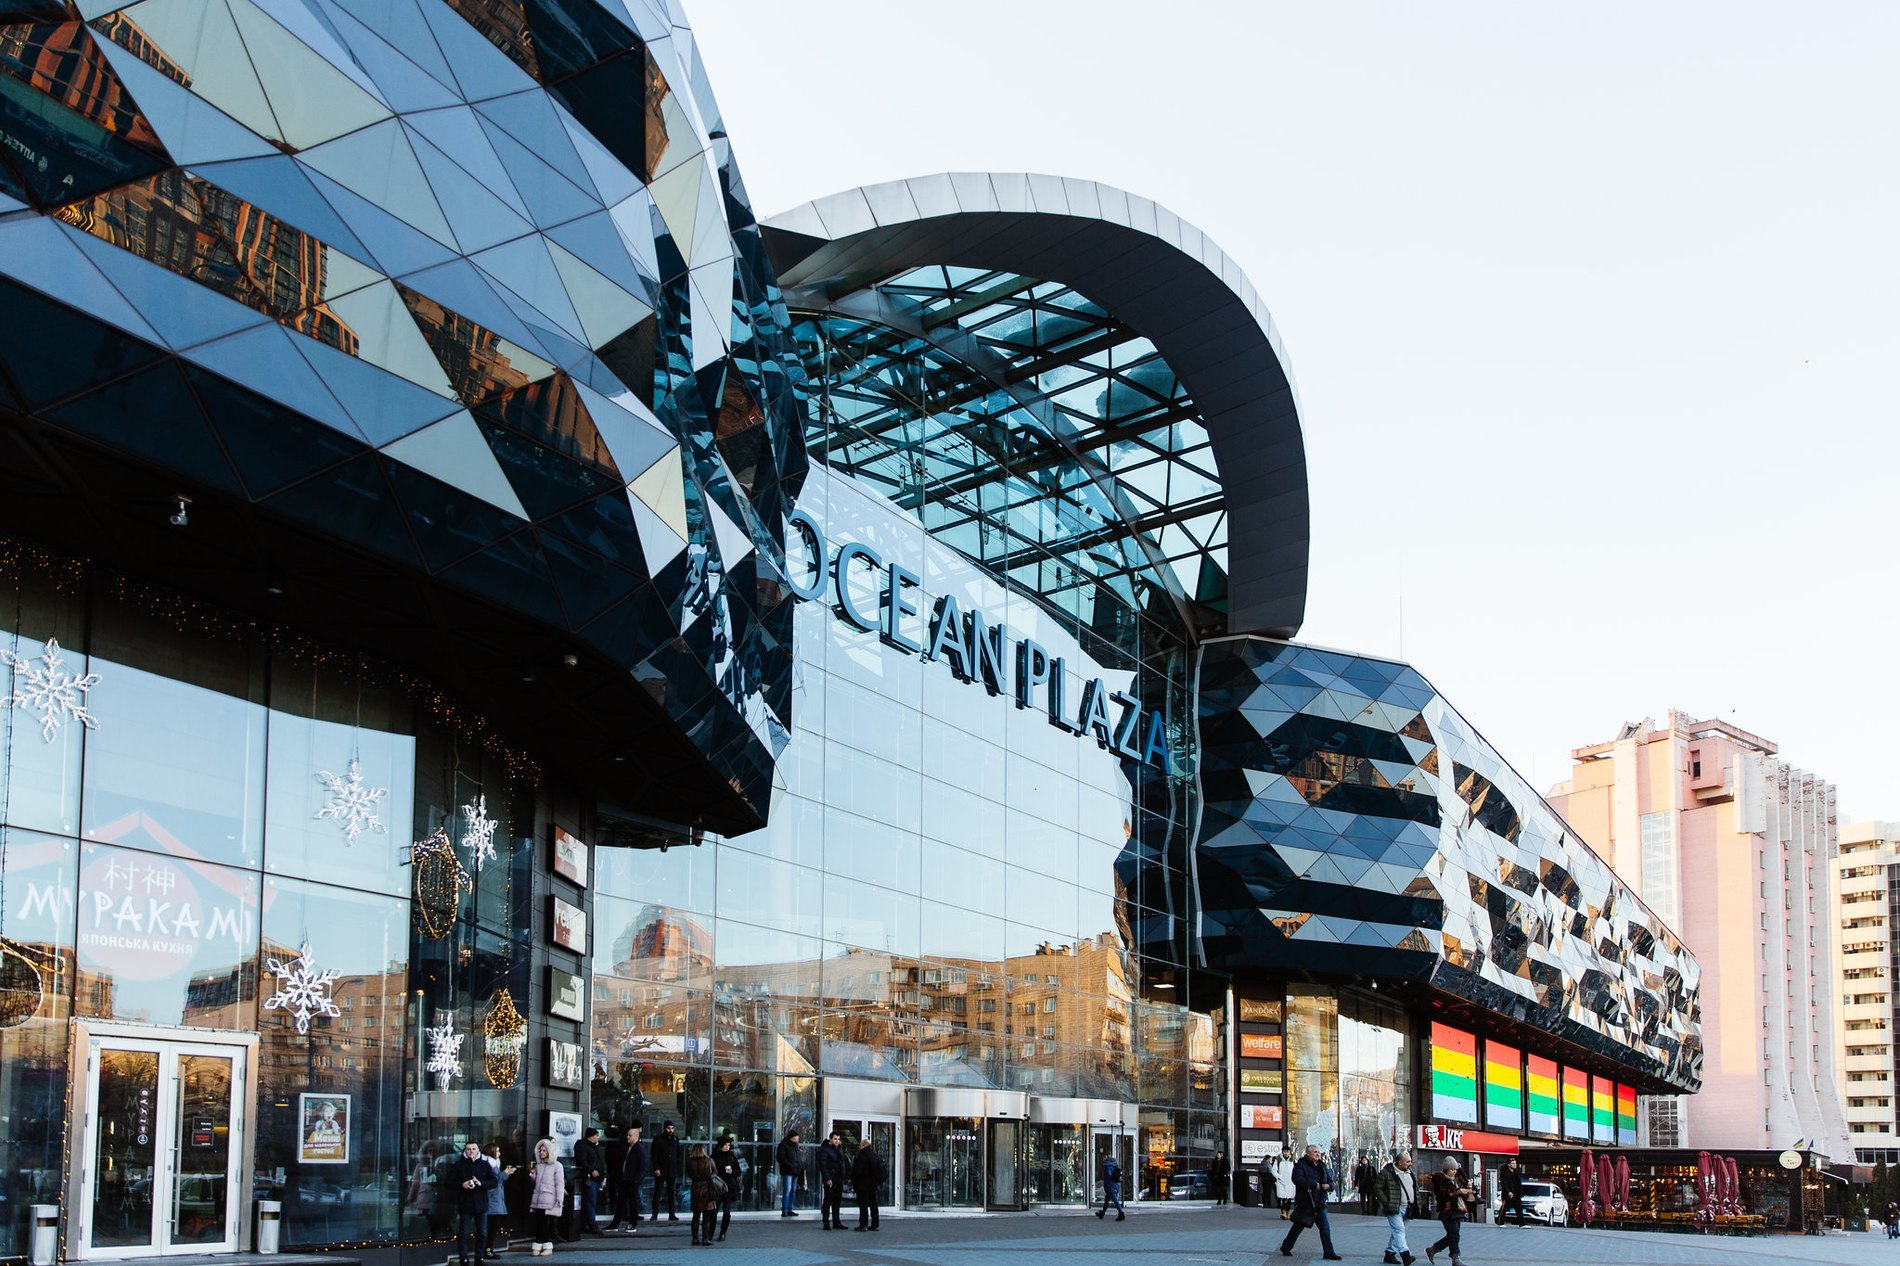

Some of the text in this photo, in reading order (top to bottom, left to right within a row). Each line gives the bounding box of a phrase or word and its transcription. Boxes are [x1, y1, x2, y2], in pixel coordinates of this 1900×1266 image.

[785, 508, 1172, 775] OCEAN PLAZA
[103, 857, 176, 896] 村神
[81, 932, 193, 955] ЯПОНСЬКА КУХНЯ
[1243, 1037, 1281, 1049] welfare
[314, 1133, 340, 1142] Меню
[1446, 1129, 1463, 1148] KFC
[1257, 1143, 1280, 1153] estro
